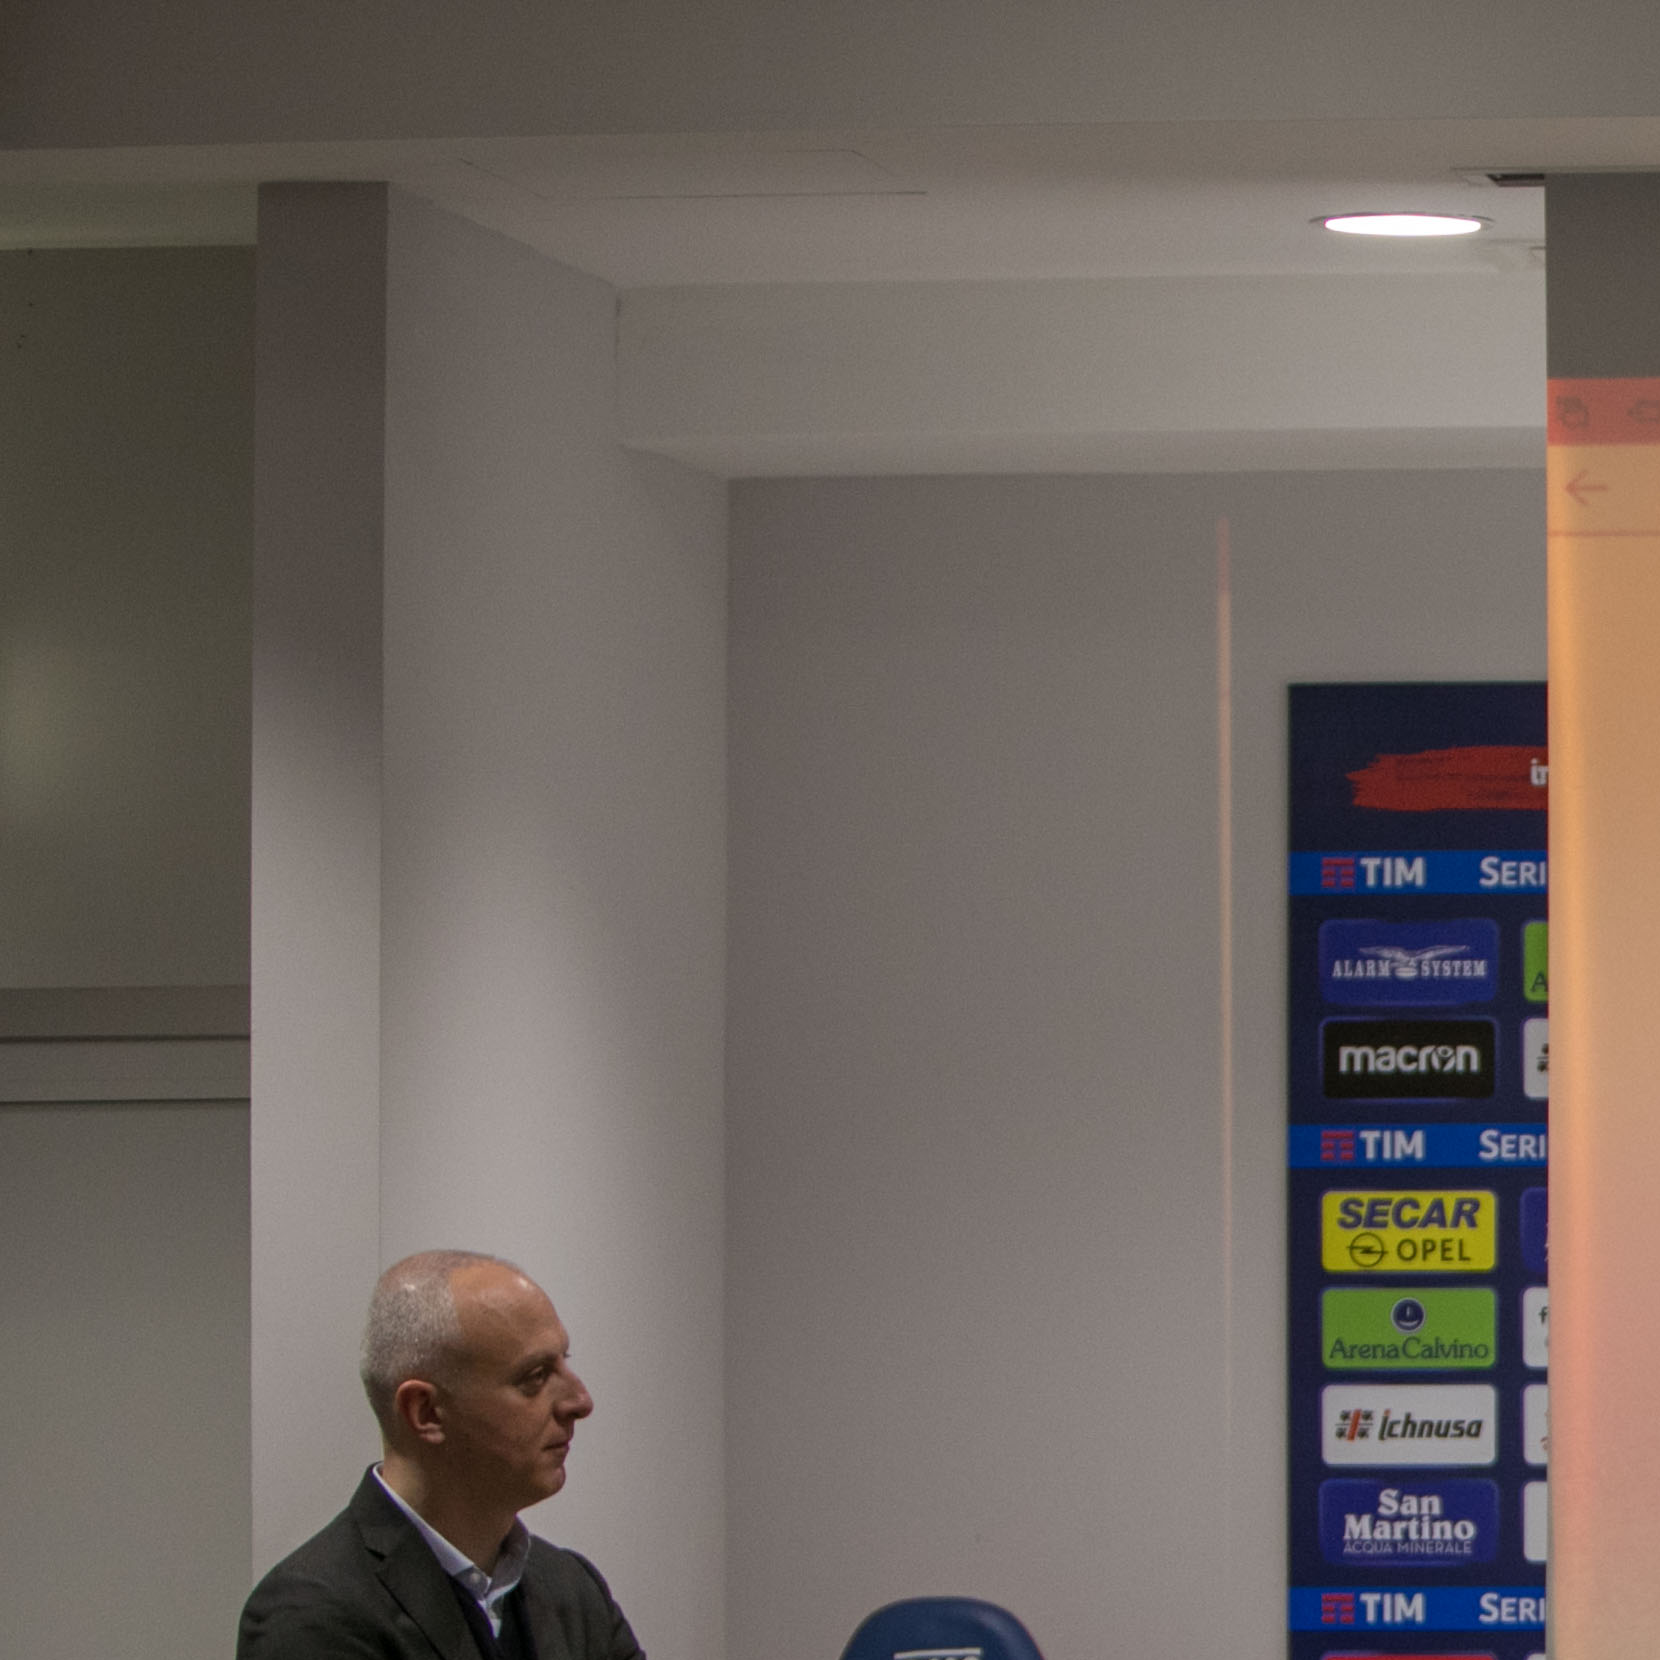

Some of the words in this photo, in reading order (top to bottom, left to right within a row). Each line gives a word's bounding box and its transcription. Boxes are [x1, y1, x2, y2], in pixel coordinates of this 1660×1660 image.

[1361, 857, 1427, 888] TIM
[1479, 856, 1548, 888] SERI
[1332, 959, 1391, 978] ALARM
[1421, 959, 1487, 978] SYSTEM
[1339, 1044, 1481, 1074] macron
[1361, 1129, 1426, 1160] TIM
[1478, 1129, 1548, 1160] SERI
[1337, 1197, 1480, 1230] SECAR
[1397, 1238, 1472, 1263] OPEL
[1379, 1408, 1484, 1441] ichnusa
[1378, 1487, 1442, 1516] San
[1344, 1513, 1477, 1541] Martino
[1343, 1540, 1394, 1554] ACQUA
[1396, 1540, 1474, 1554] MINERALE
[1361, 1592, 1426, 1624] TIM
[1478, 1592, 1546, 1624] SERI
